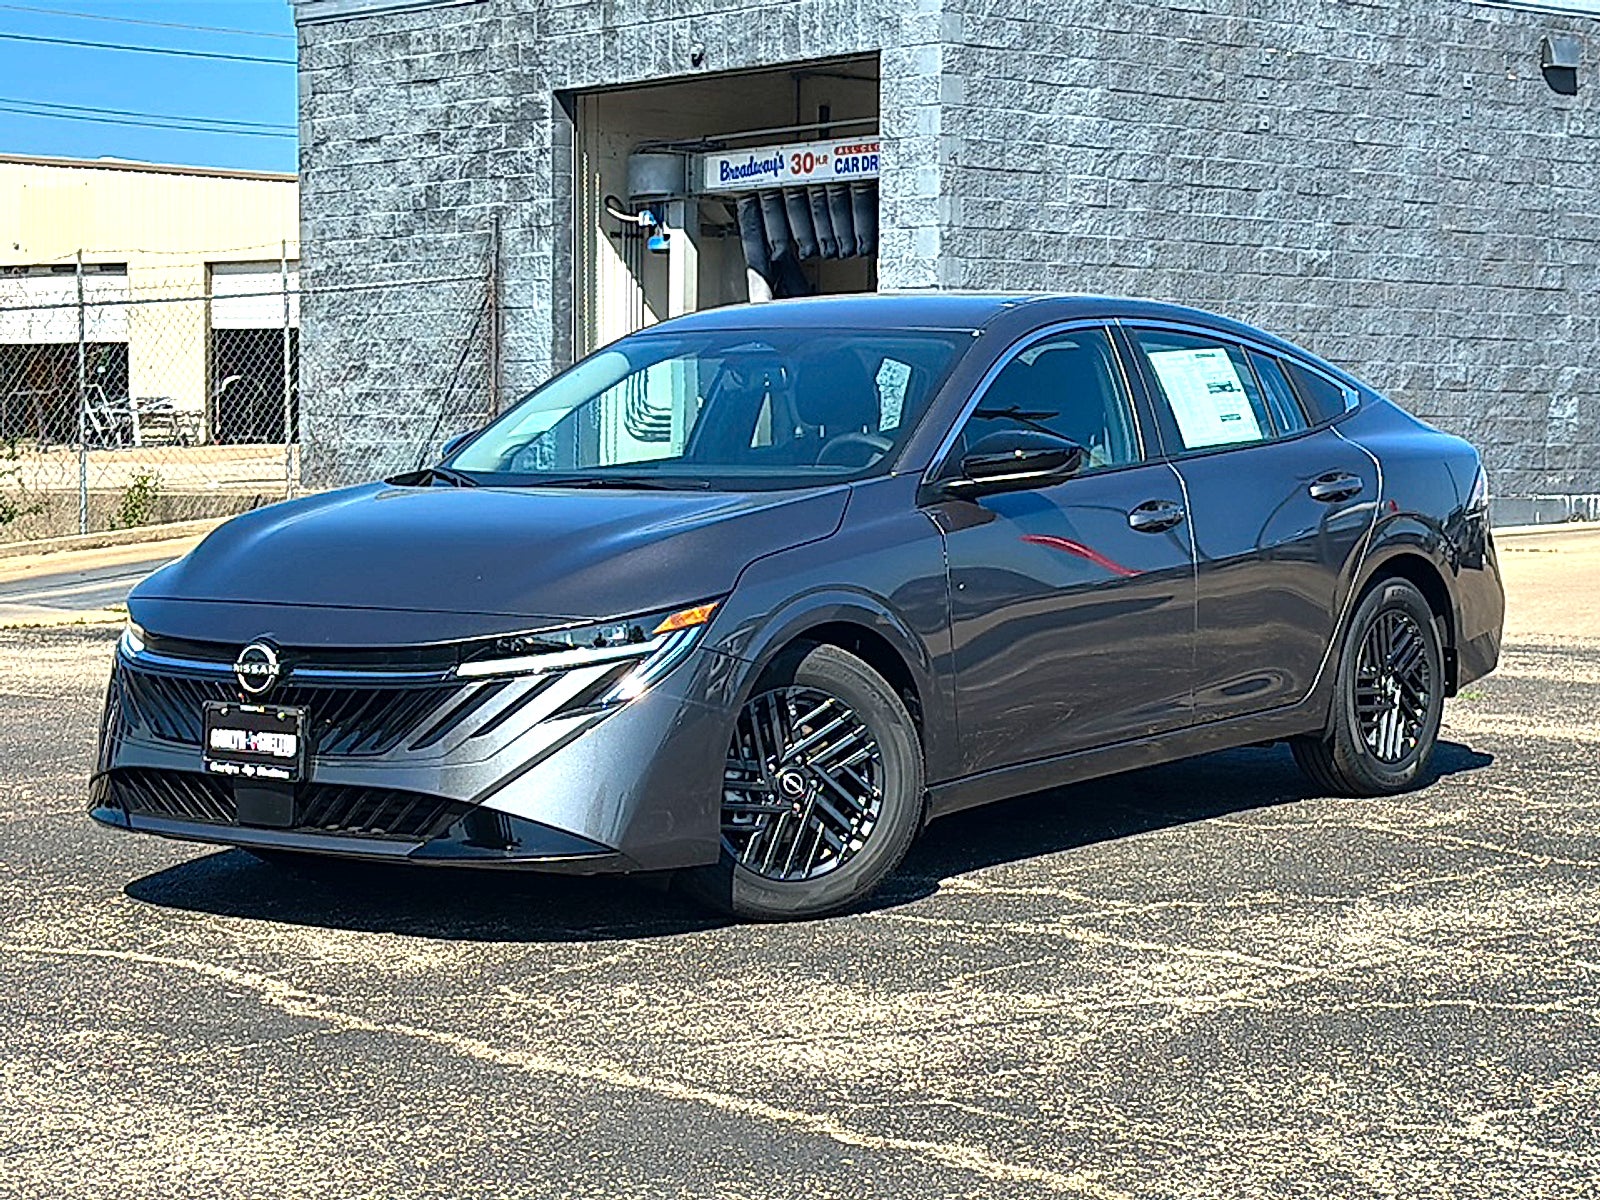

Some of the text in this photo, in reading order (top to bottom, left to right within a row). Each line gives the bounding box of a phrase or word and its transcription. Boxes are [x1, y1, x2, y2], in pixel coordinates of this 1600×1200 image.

[720, 151, 785, 181] Broadway's
[790, 152, 814, 175] 30
[834, 156, 860, 175] CAR
[233, 663, 280, 676] NISSAN
